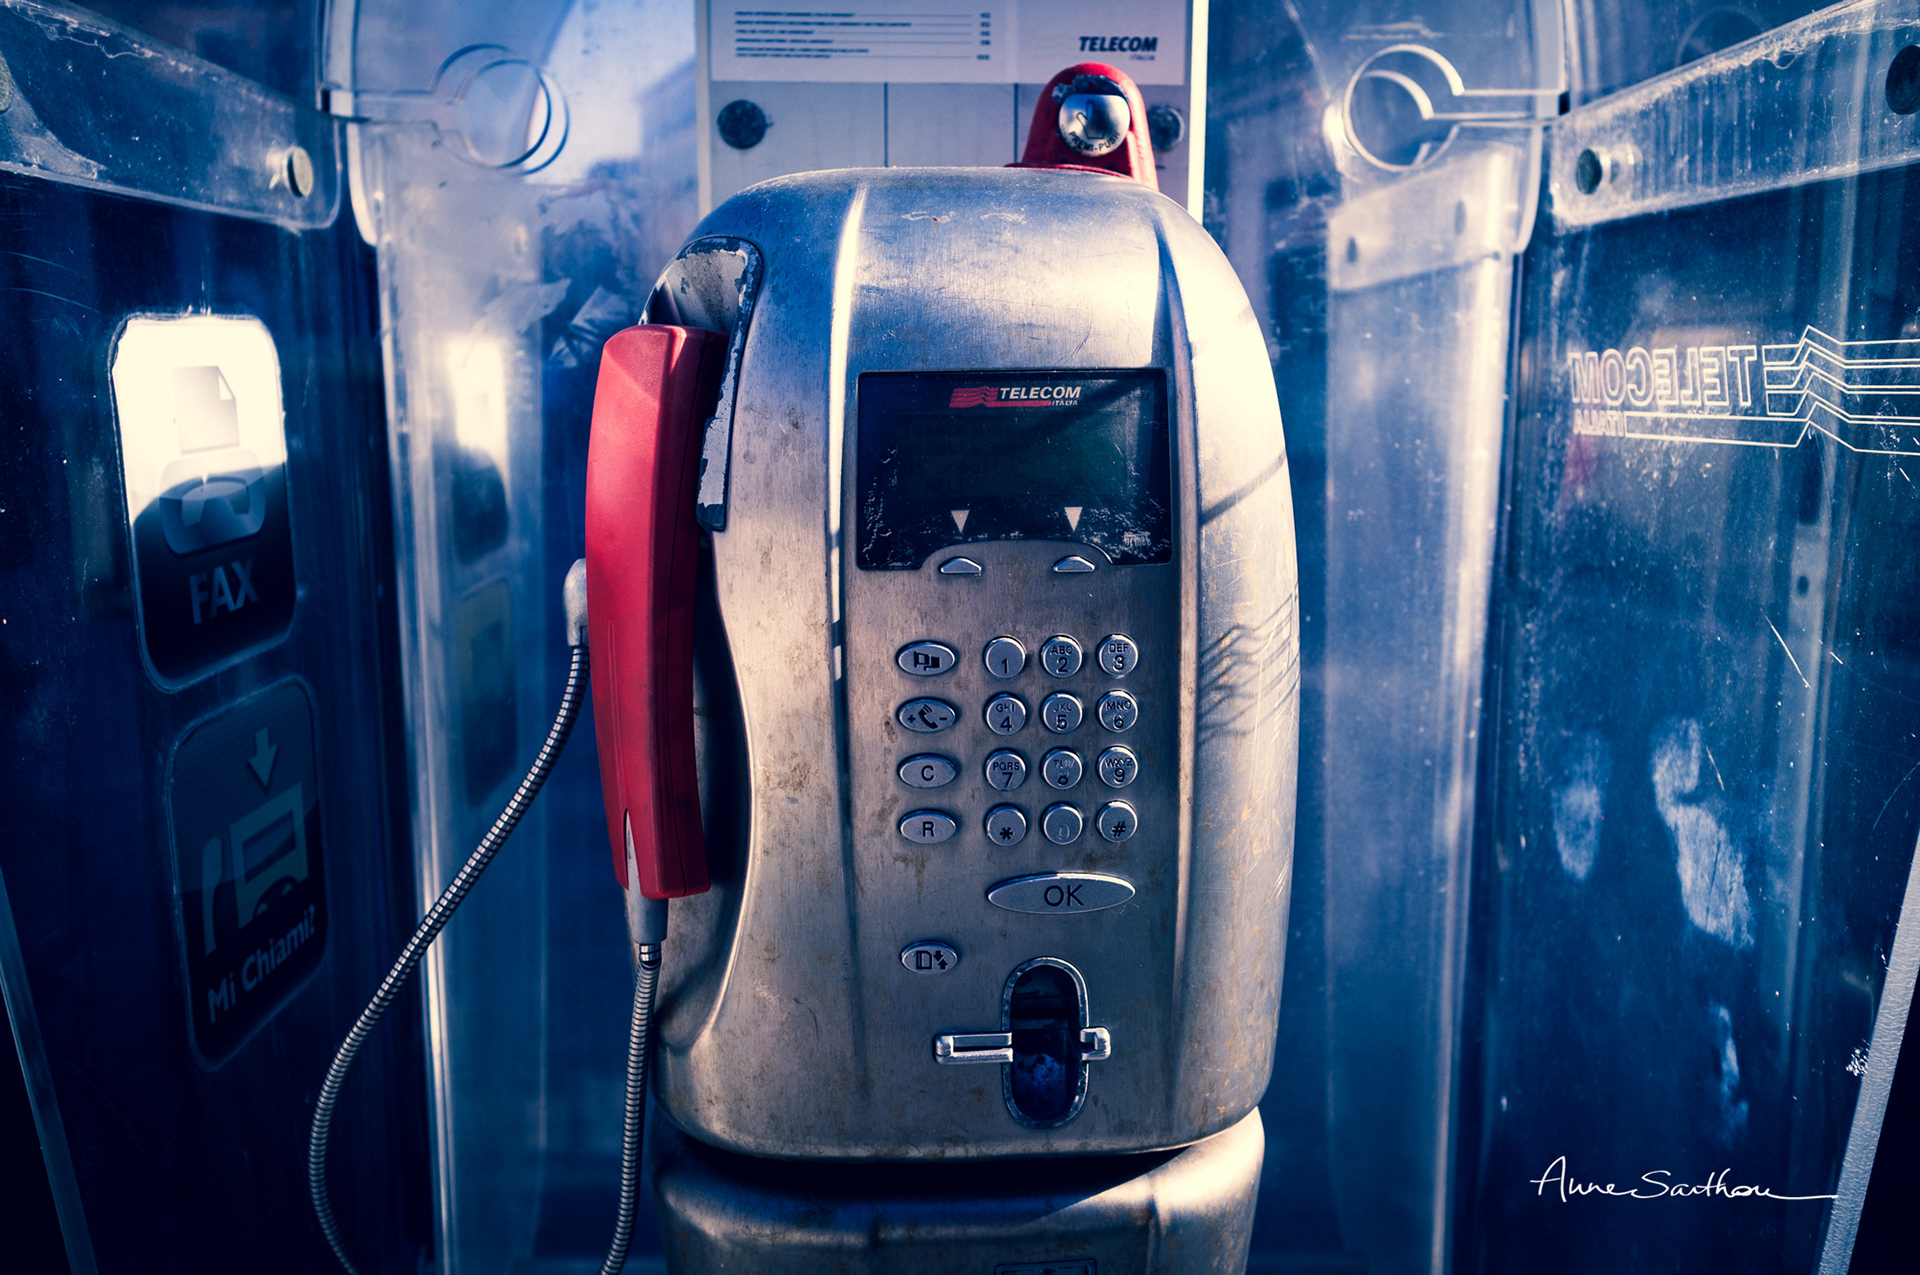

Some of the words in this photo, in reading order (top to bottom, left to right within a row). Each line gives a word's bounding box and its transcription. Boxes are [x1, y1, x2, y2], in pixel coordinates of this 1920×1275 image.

[1079, 36, 1158, 52] TELECOM
[1000, 386, 1081, 399] TELECOM
[188, 556, 259, 625] FAX
[1051, 645, 1073, 655] ABC
[1108, 644, 1128, 653] DEF
[1001, 658, 1009, 674] 1
[1057, 658, 1069, 673] 2
[1113, 655, 1124, 670] 3
[996, 704, 1015, 712] GHI
[1105, 701, 1131, 711] MNO
[1000, 716, 1012, 731] 4
[1056, 714, 1067, 729] 5
[1113, 713, 1125, 728] 6
[993, 762, 1020, 771] PQRS
[1105, 758, 1132, 768] WXYZ
[921, 765, 935, 781] C
[1002, 772, 1013, 786] 7
[1057, 771, 1069, 785] 8
[1113, 768, 1125, 782] 9
[922, 821, 934, 837] R
[1112, 822, 1126, 836] #
[1044, 885, 1083, 906] OK
[206, 980, 236, 1025] Mi
[241, 907, 318, 989] Chiami?
